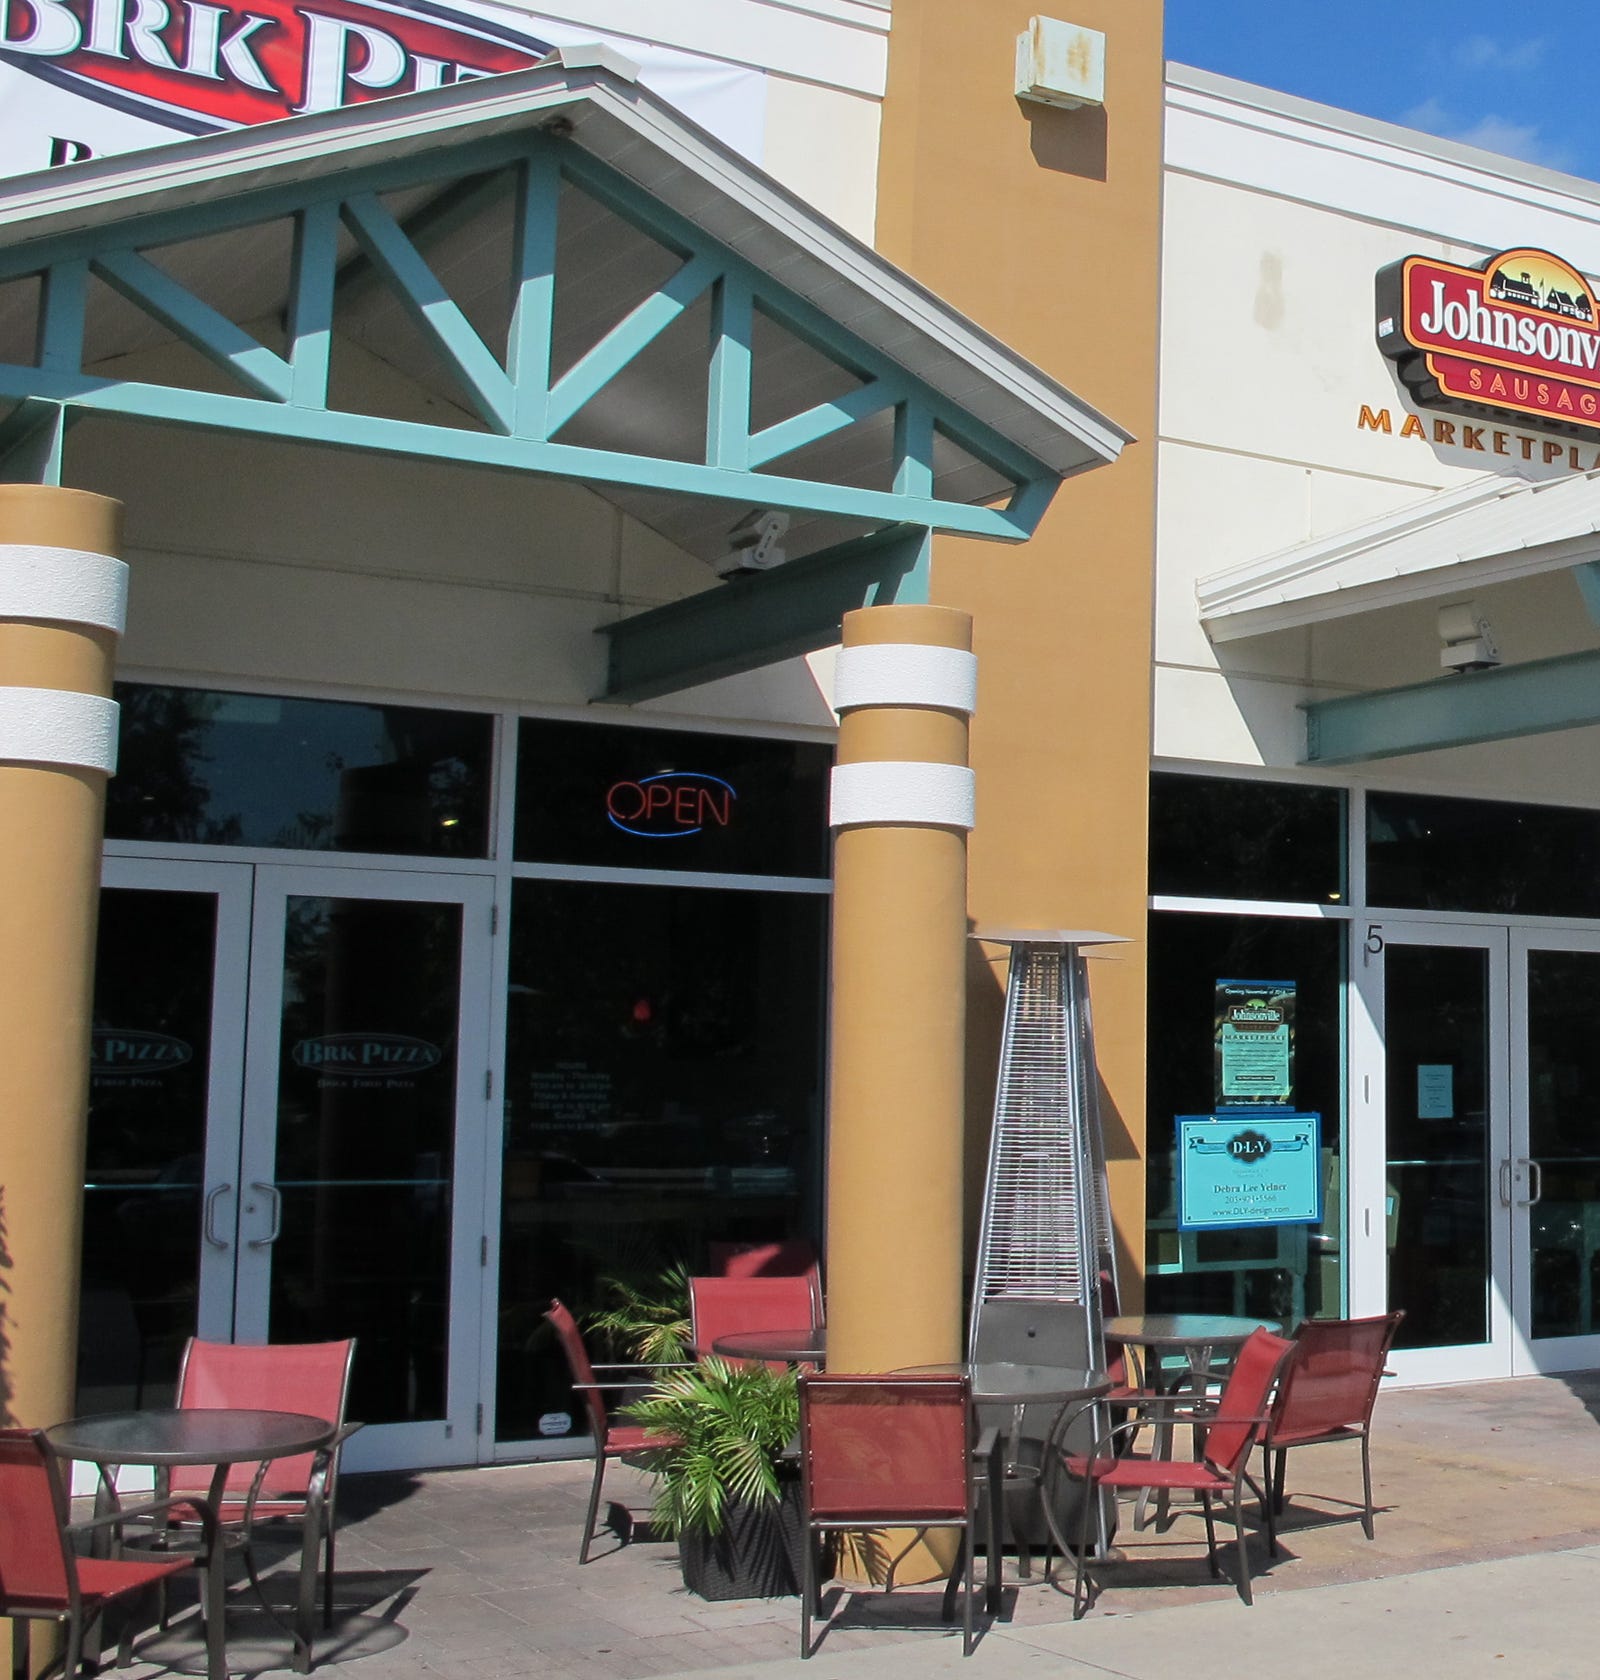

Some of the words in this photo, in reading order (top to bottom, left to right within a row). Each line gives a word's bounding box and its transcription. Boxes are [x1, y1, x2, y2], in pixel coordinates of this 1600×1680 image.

[606, 780, 730, 826] OPEN
[1366, 924, 1384, 954] 5
[1231, 1008, 1281, 1021] Johnsonville
[104, 1038, 185, 1063] PIZZA
[301, 1039, 357, 1065] BRK
[361, 1041, 434, 1065] PIZZA
[1213, 1184, 1241, 1194] Debra
[1243, 1184, 1259, 1192] Lee
